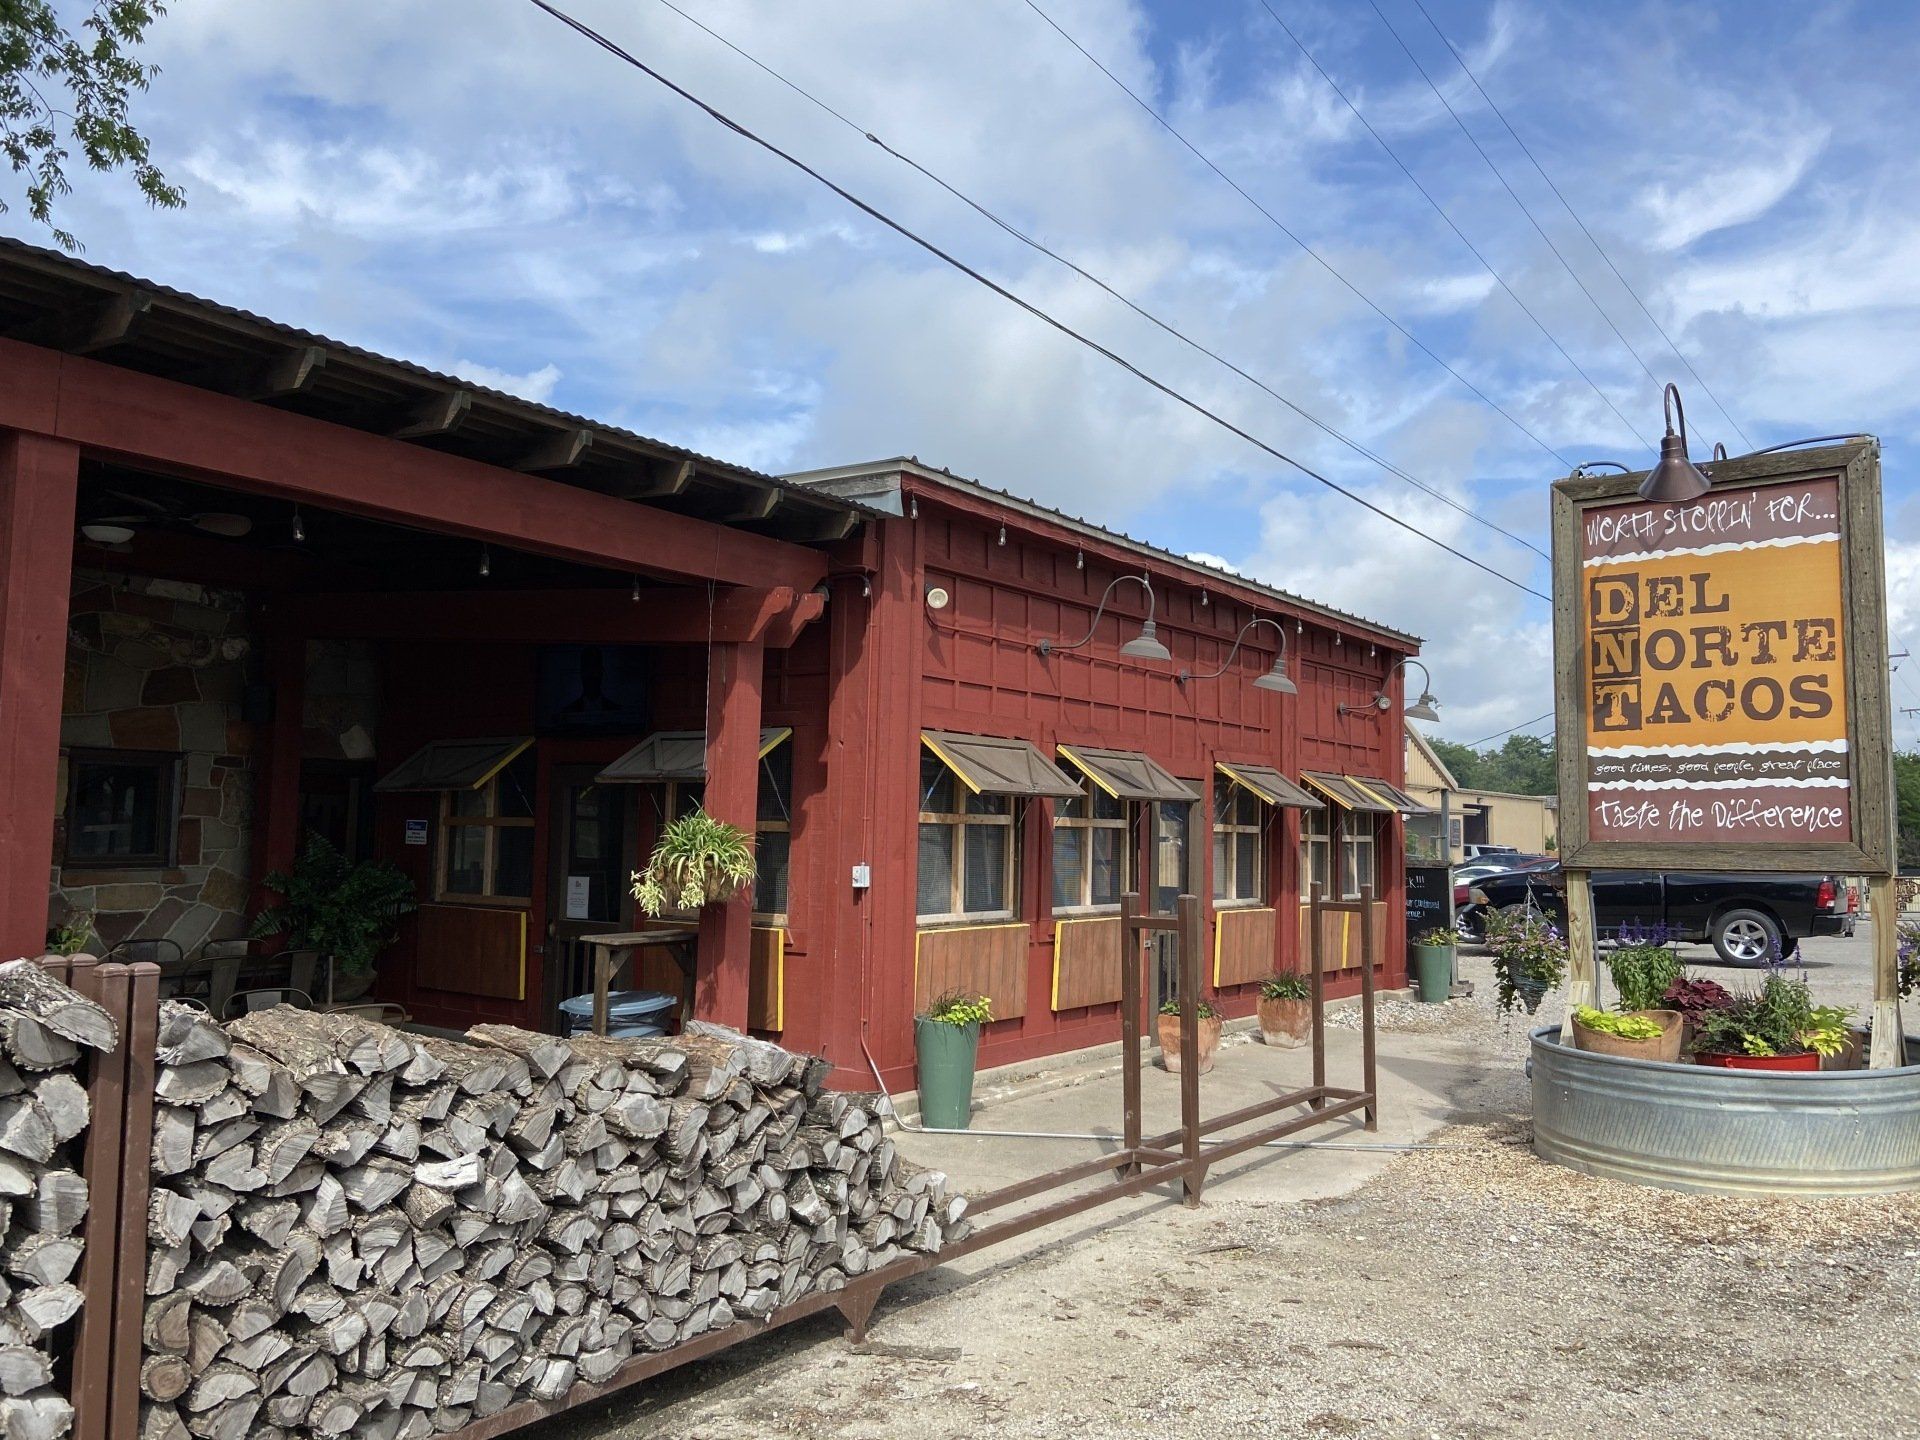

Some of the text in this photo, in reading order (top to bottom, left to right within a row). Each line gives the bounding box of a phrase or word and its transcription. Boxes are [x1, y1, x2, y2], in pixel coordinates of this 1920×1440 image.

[1587, 492, 1836, 546] WORTH STOPPIN' FOR...
[1590, 572, 1730, 628] DEL
[1591, 617, 1836, 680] NORTE
[1592, 673, 1833, 733] TACOS
[1593, 757, 1841, 776] good times, good people, great place
[1594, 798, 1843, 833] Taste the Difference
